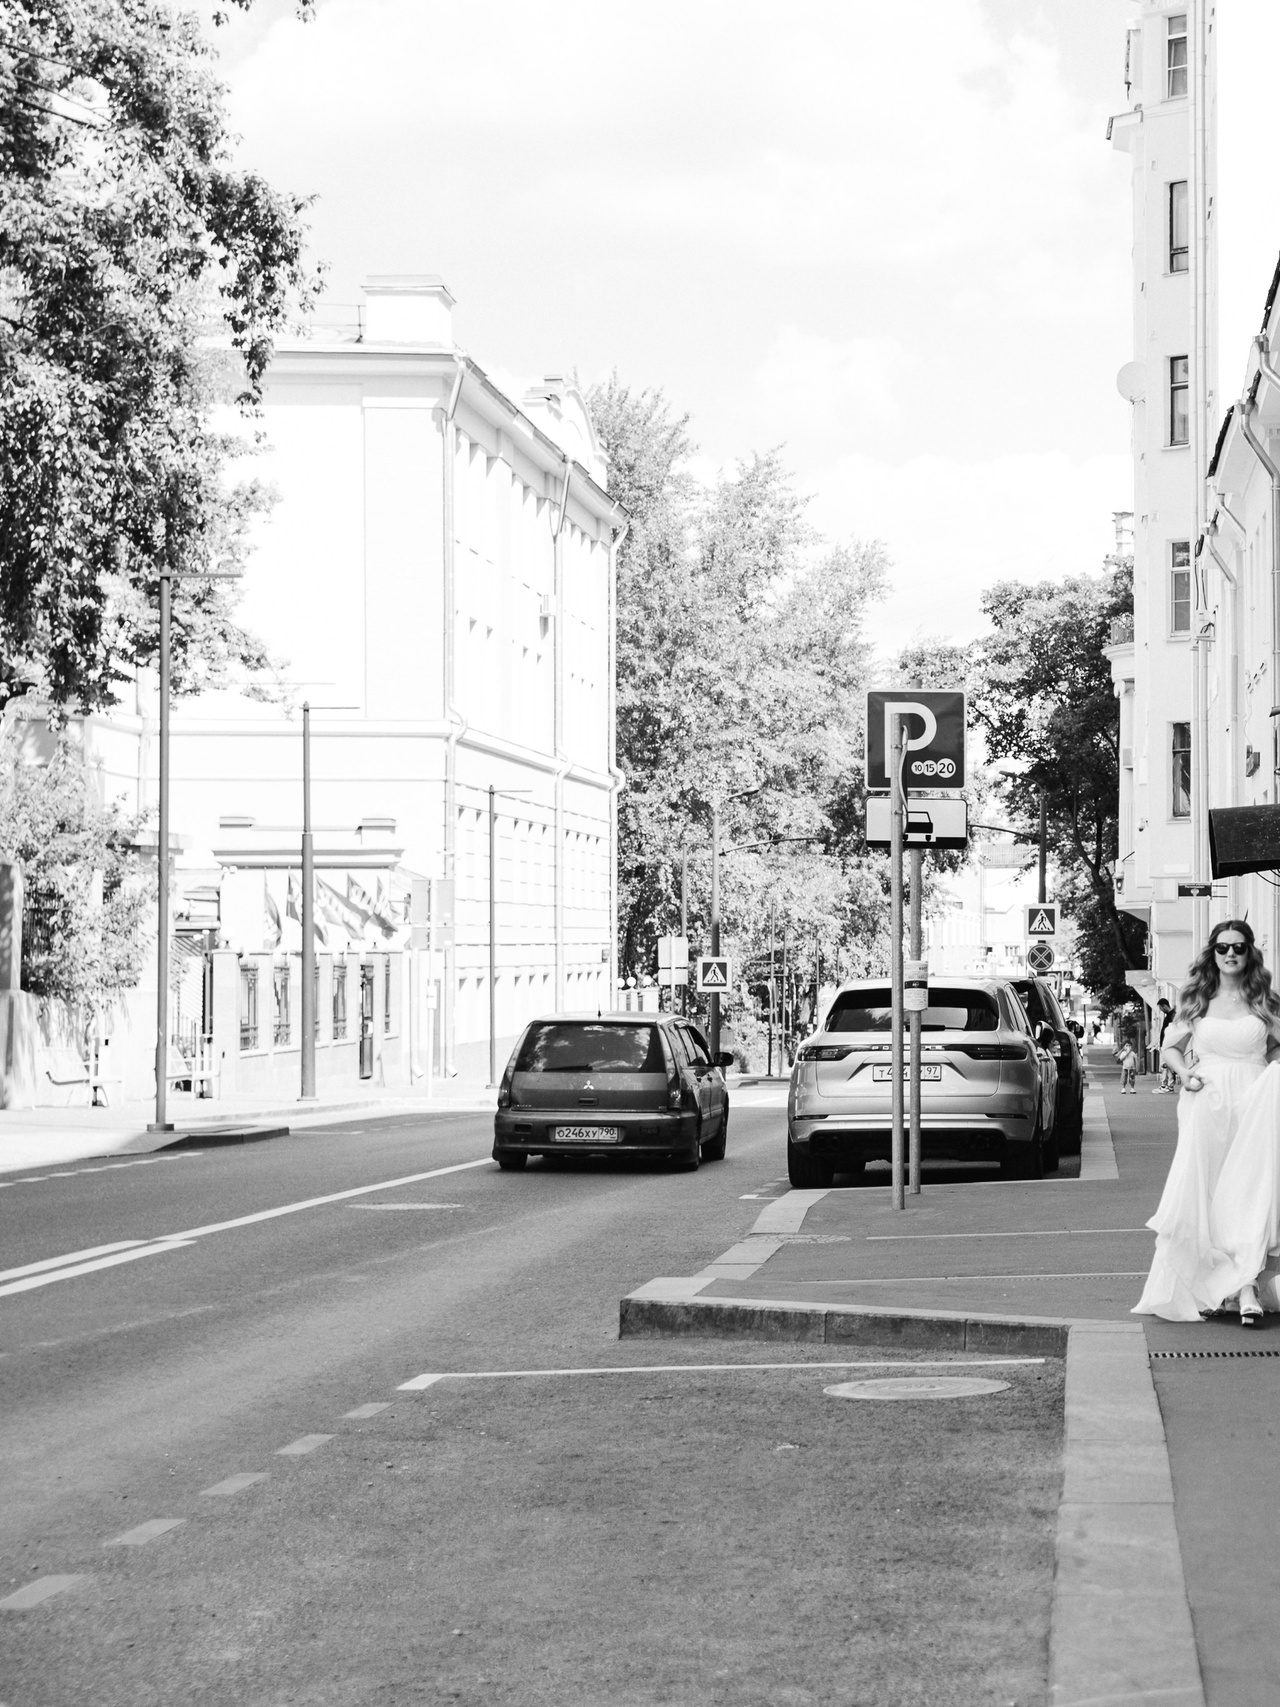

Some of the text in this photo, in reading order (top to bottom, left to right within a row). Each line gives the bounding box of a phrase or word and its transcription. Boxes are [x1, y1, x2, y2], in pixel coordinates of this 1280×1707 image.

[914, 762, 955, 775] 10 15 20
[926, 1066, 938, 1075] 97
[600, 1127, 615, 1136] 790
